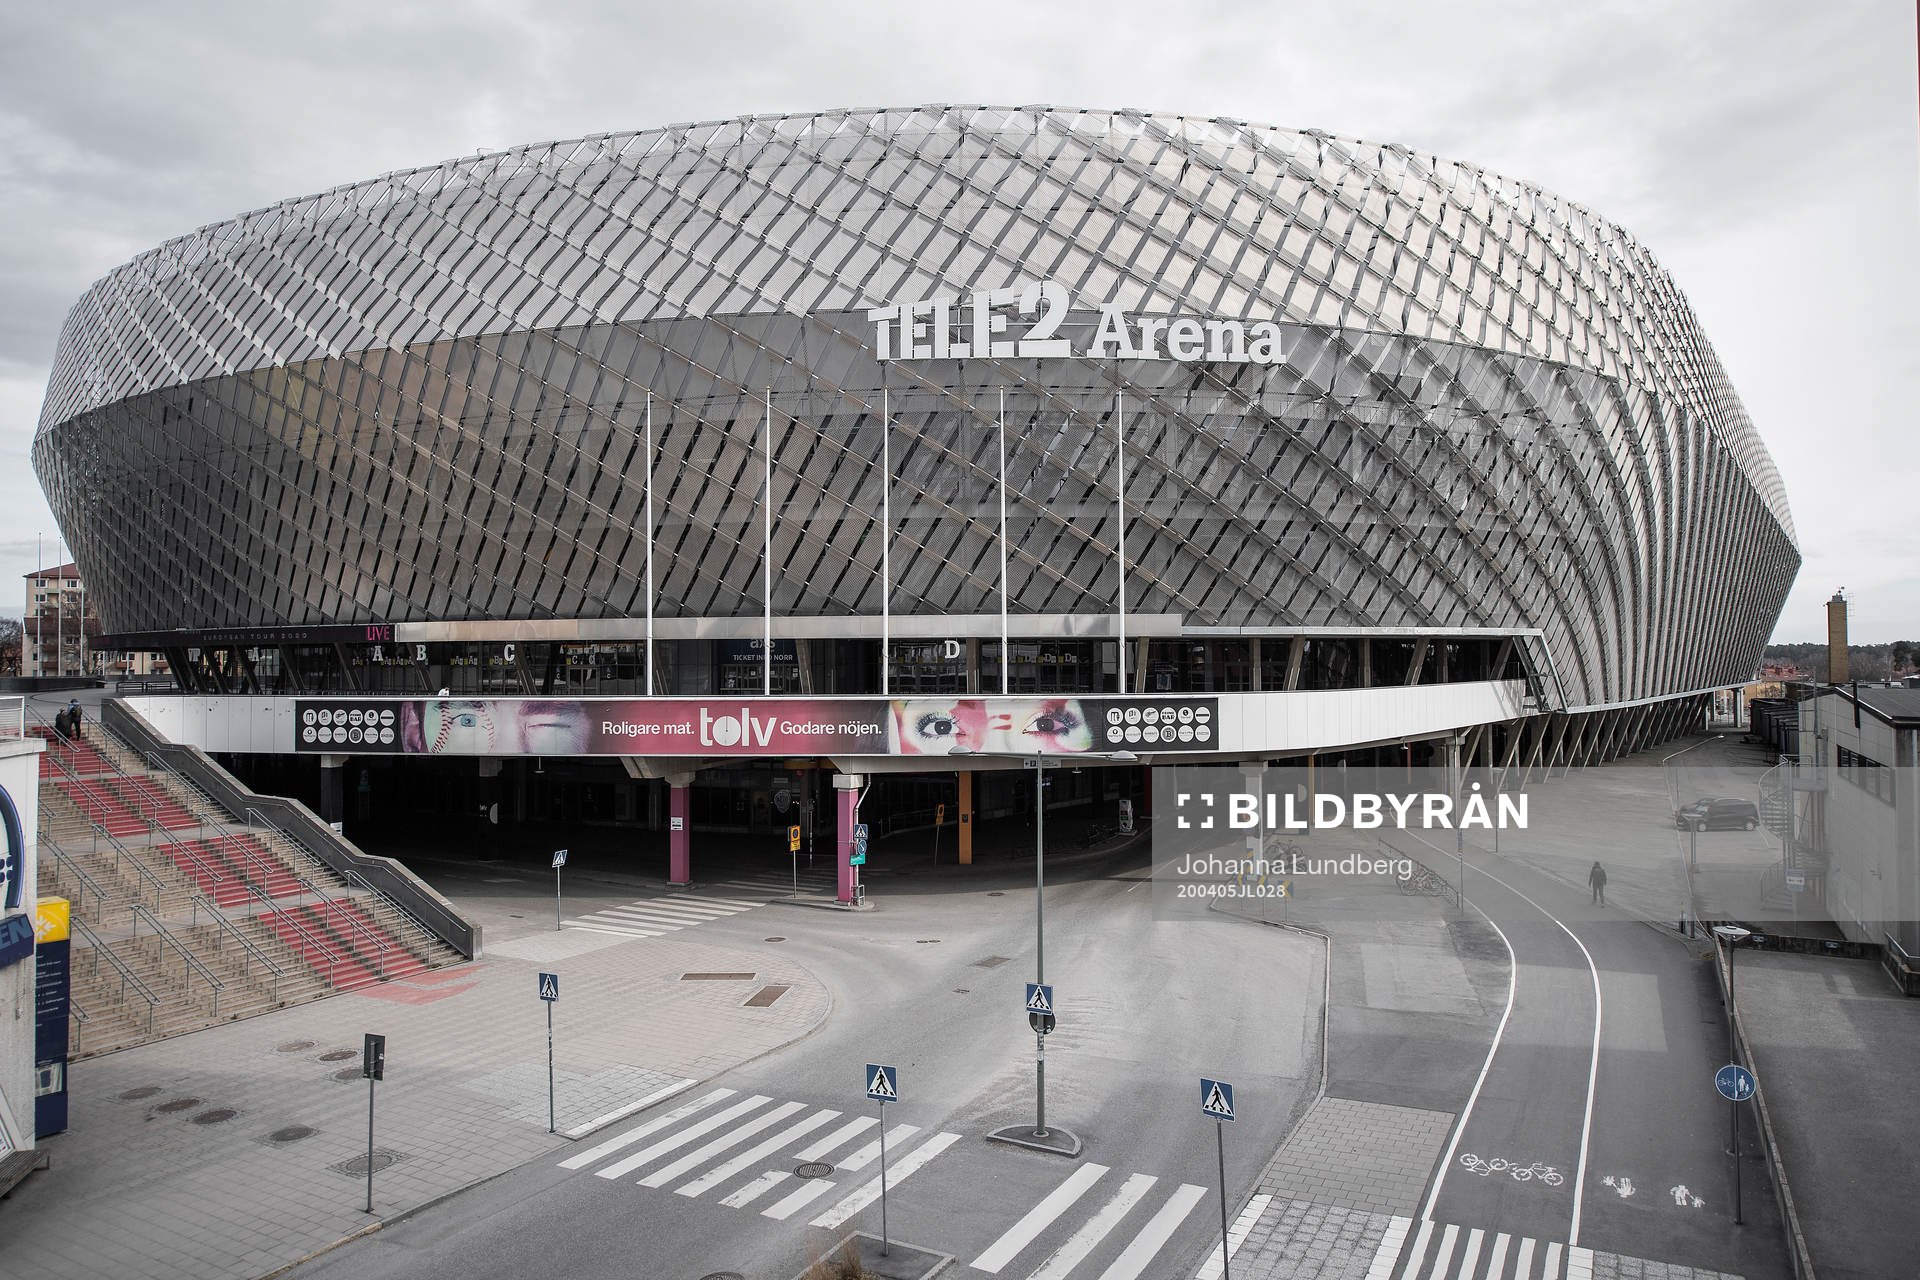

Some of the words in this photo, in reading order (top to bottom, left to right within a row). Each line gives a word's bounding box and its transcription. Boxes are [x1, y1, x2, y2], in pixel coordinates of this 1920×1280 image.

[868, 280, 1071, 361] TELE2
[1086, 302, 1287, 365] Arena
[367, 626, 391, 641] LIVE
[372, 645, 384, 661] A
[415, 644, 427, 661] B
[504, 644, 516, 661] C
[944, 640, 960, 659] D
[602, 721, 660, 737] Roligare
[663, 722, 695, 735] mat.
[700, 707, 777, 747] tolv
[780, 721, 835, 735] Godare
[838, 721, 882, 737] nöjen.
